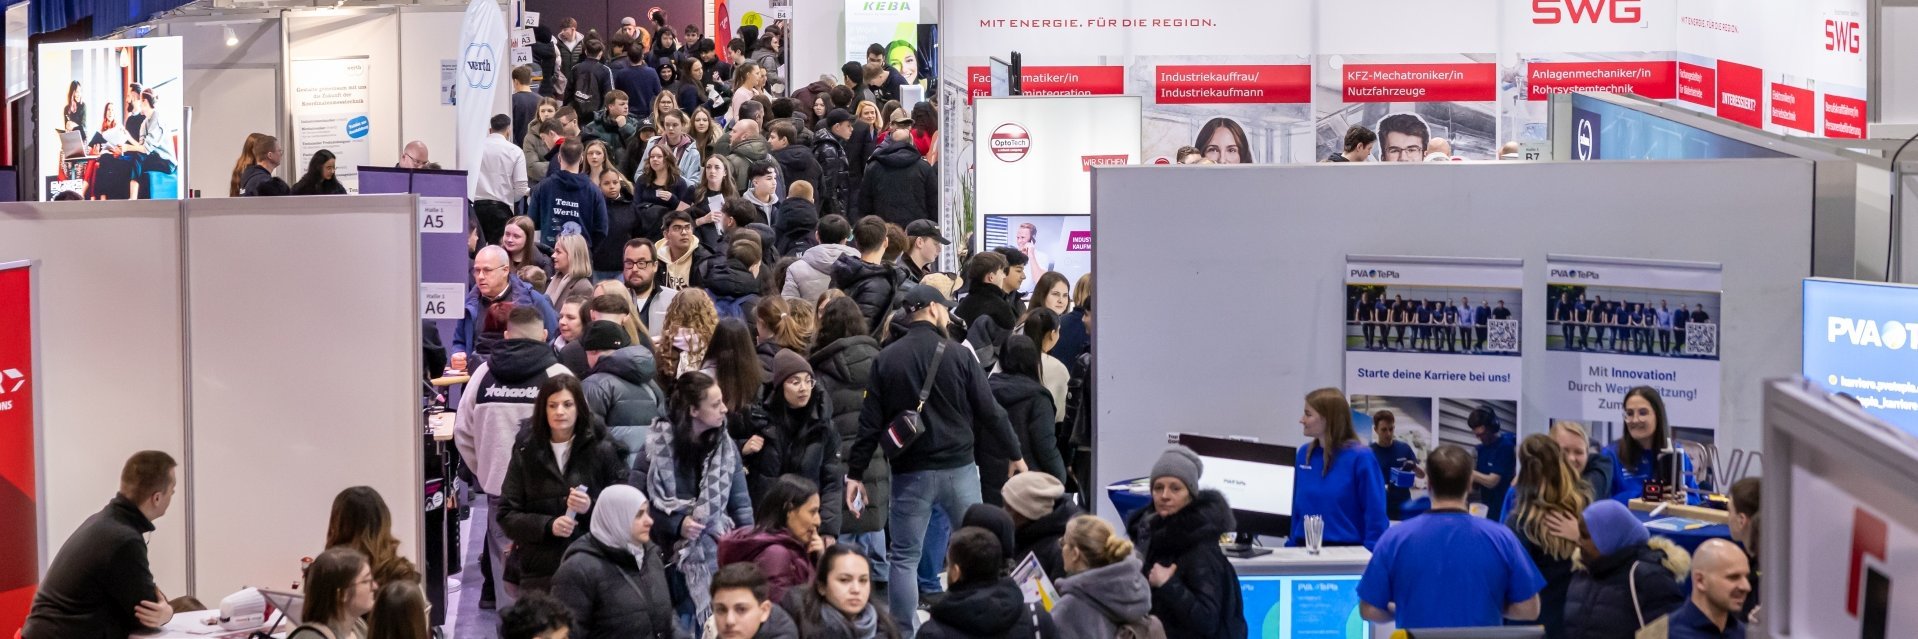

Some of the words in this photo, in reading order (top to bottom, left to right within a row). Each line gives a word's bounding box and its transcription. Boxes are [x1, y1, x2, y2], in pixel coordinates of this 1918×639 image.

[863, 2, 910, 10] KEBA
[1532, 0, 1641, 24] SWG
[980, 19, 1005, 27] MIT
[1009, 19, 1083, 27] ENERGIE.
[1088, 17, 1117, 27] FÜR
[1122, 19, 1147, 27] DIE
[1152, 18, 1217, 27] REGION.
[521, 36, 530, 44] A3
[1825, 20, 1860, 54] SWG
[467, 59, 492, 71] werth
[973, 73, 1078, 84] Facmatiker/in
[1161, 72, 1260, 82] Industriekauffrau/
[1348, 70, 1464, 80] KFZ-Mechatroniker/in
[1532, 68, 1651, 81] Anlagenmechaniker/in
[973, 88, 990, 96] für
[1161, 88, 1264, 97] Industriekaufmann
[1348, 86, 1426, 97] Nutzfahrzeuge
[1532, 84, 1634, 94] Rohrsystemtechnik
[1722, 92, 1756, 111] INTERESSIERT?
[1083, 158, 1096, 166] WIR
[555, 198, 579, 208] Team
[553, 208, 580, 218] Werth
[424, 215, 444, 228] A5
[1351, 269, 1368, 278] PVA
[1377, 270, 1400, 279] TePla
[1551, 269, 1569, 278] PVA
[1577, 270, 1599, 280] TePla
[425, 301, 446, 314] A6
[1828, 316, 1882, 348] PVA
[1358, 368, 1390, 379] Starte
[1392, 369, 1421, 380] deine
[1424, 370, 1466, 381] Karriere
[1469, 372, 1485, 382] bei
[1488, 373, 1510, 382] uns!
[1589, 366, 1608, 376] Mit
[1612, 367, 1676, 381] Innovation!
[1568, 380, 1602, 392] Durch
[1605, 383, 1697, 400] Wertätzung!
